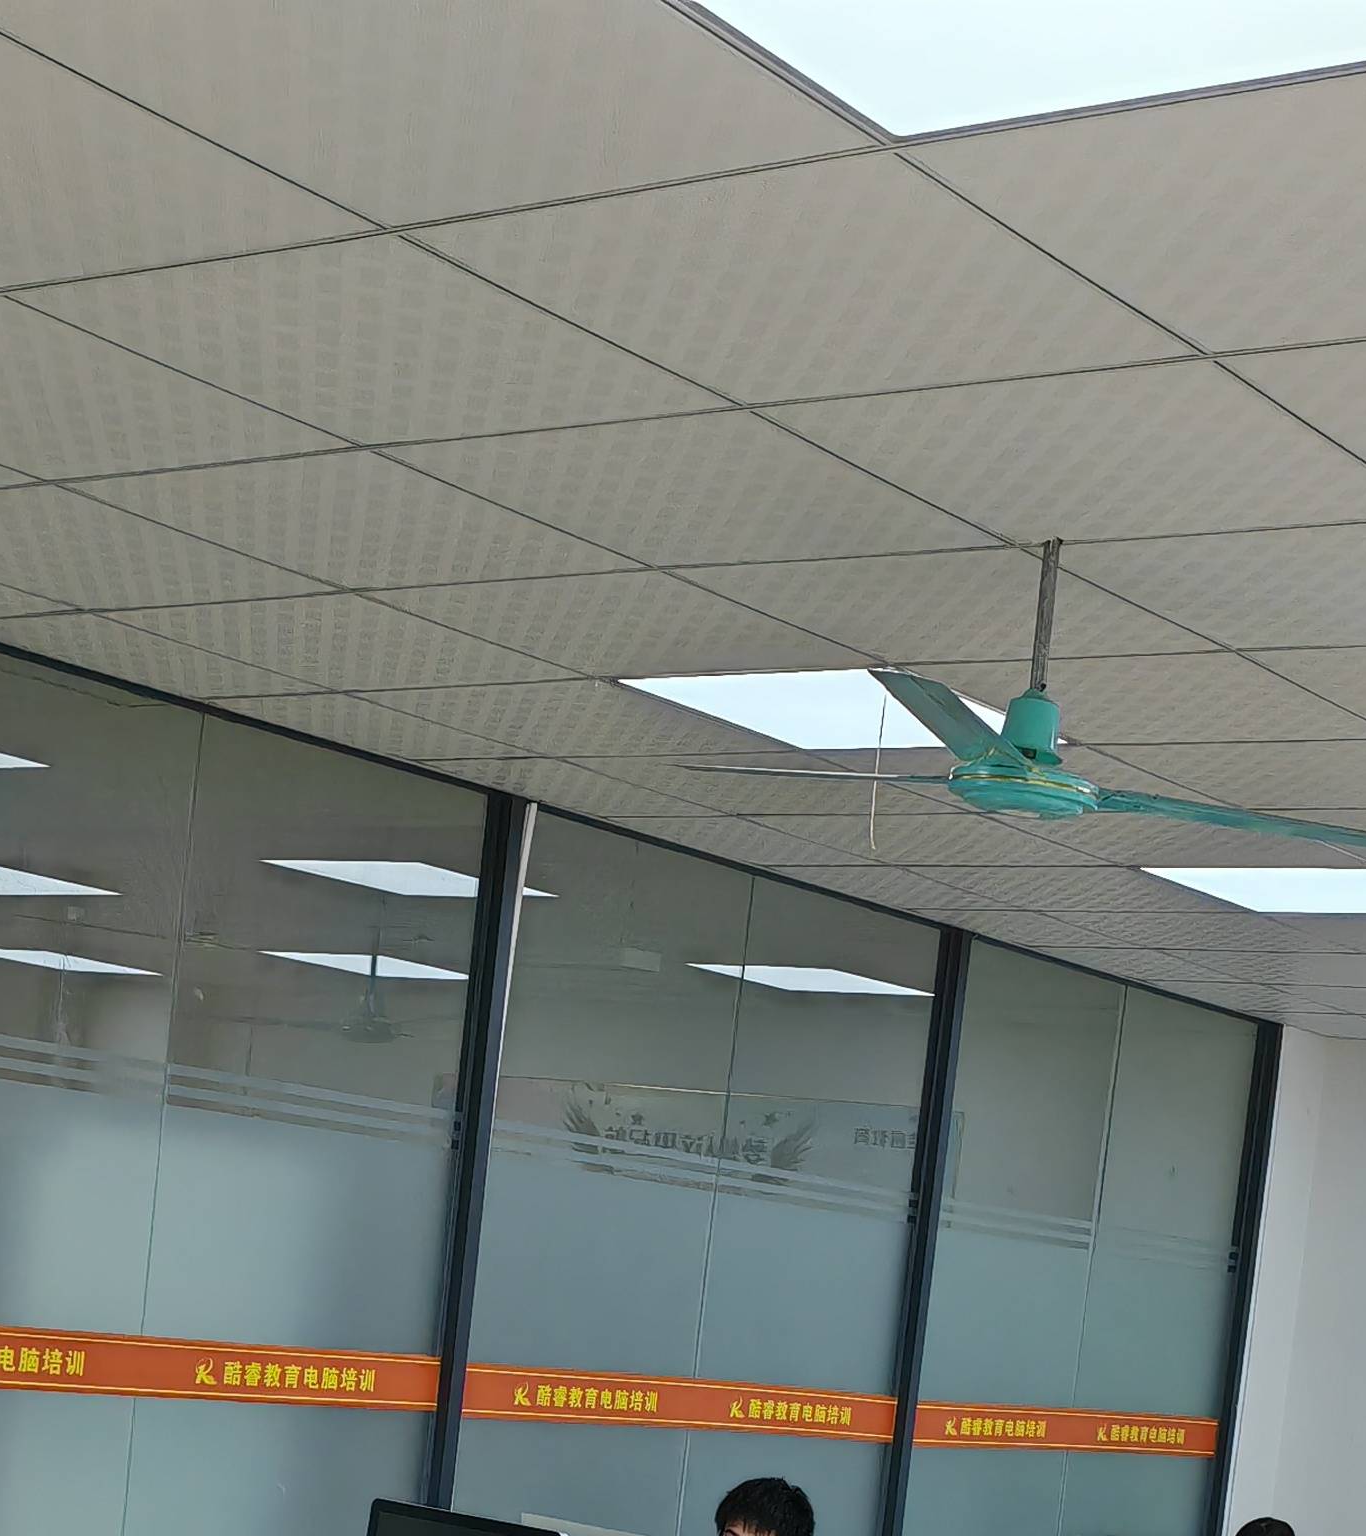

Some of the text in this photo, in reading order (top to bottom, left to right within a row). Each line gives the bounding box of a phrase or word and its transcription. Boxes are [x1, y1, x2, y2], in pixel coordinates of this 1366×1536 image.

[222, 1361, 377, 1393] 酷睿教育电脑培训
[536, 1385, 659, 1413] 酷睿教育电脑培训
[748, 1399, 852, 1426] 酷睿教育电脑培训
